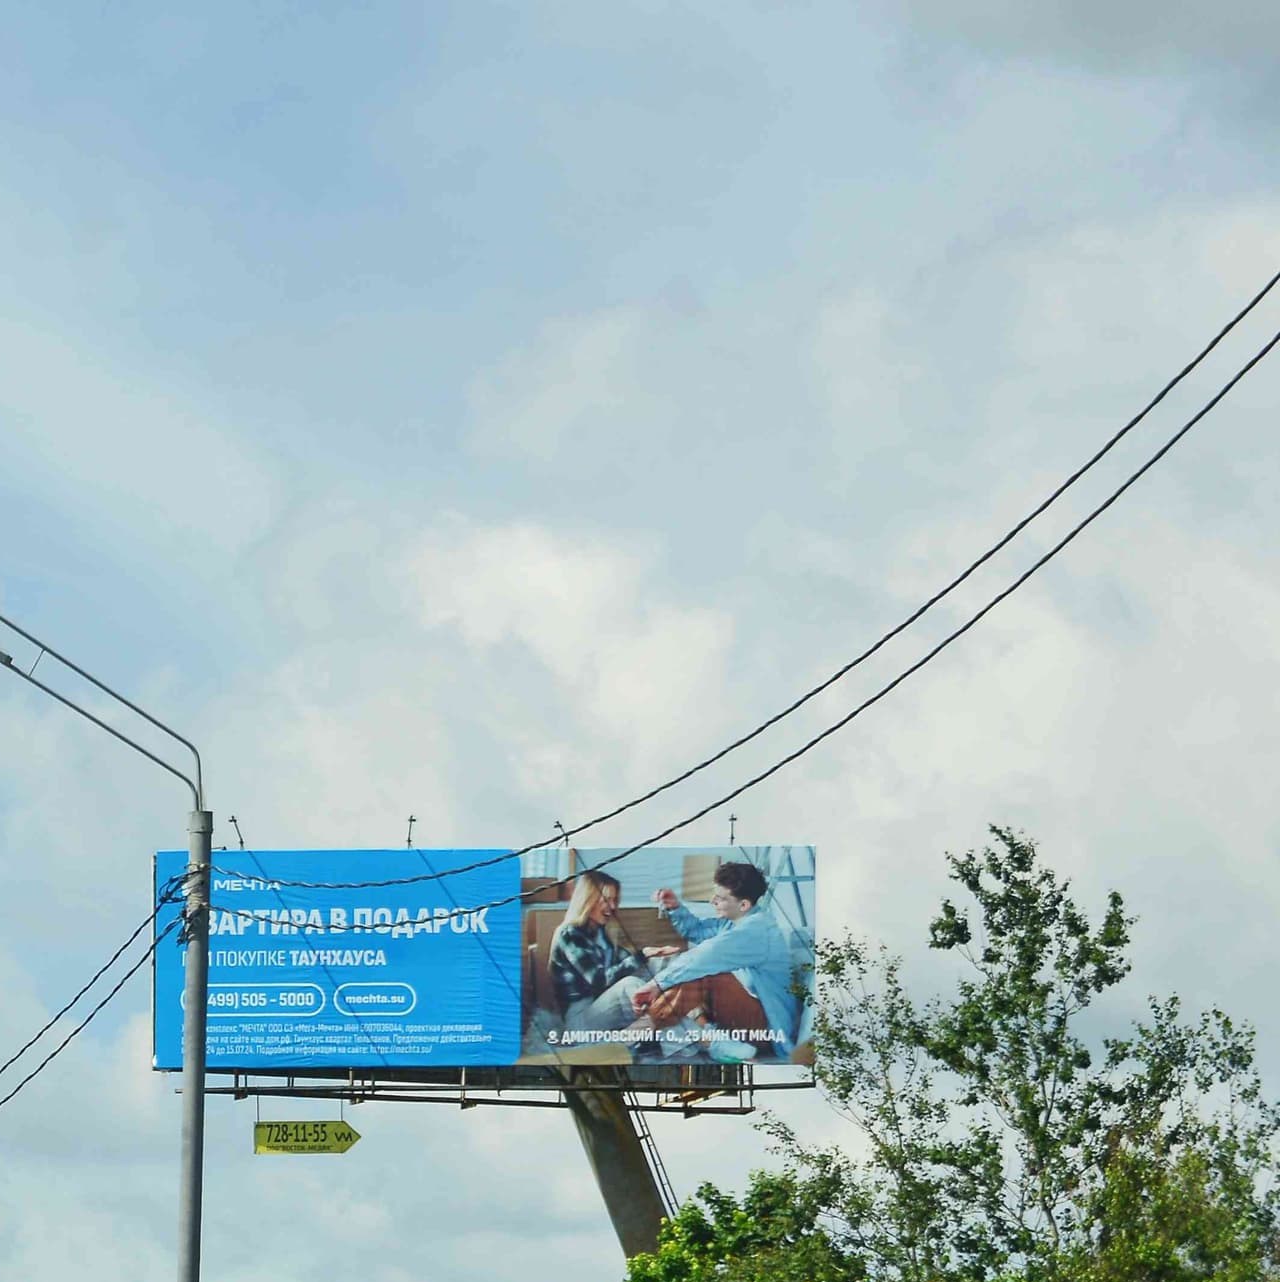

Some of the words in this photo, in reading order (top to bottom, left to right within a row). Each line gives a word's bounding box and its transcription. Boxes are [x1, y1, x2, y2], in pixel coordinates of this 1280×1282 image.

[213, 879, 282, 892] МЕЧТА
[207, 907, 326, 936] ВАРТИРА
[329, 907, 348, 934] В
[353, 907, 490, 939] ПОДАРОК
[216, 950, 286, 967] ПОКУПКЕ
[289, 949, 387, 967] ТАУНХАУСА
[207, 992, 239, 1008] 499)
[241, 992, 267, 1007] 505
[279, 992, 315, 1007] 5000
[344, 994, 406, 1004] mechta.su
[560, 1029, 655, 1045] ДМИТРОВСКИЙ
[701, 1029, 730, 1043] МИН
[730, 1029, 748, 1042] ОТ
[748, 1028, 786, 1043] МКАД
[265, 1123, 328, 1144] 728-11-55
